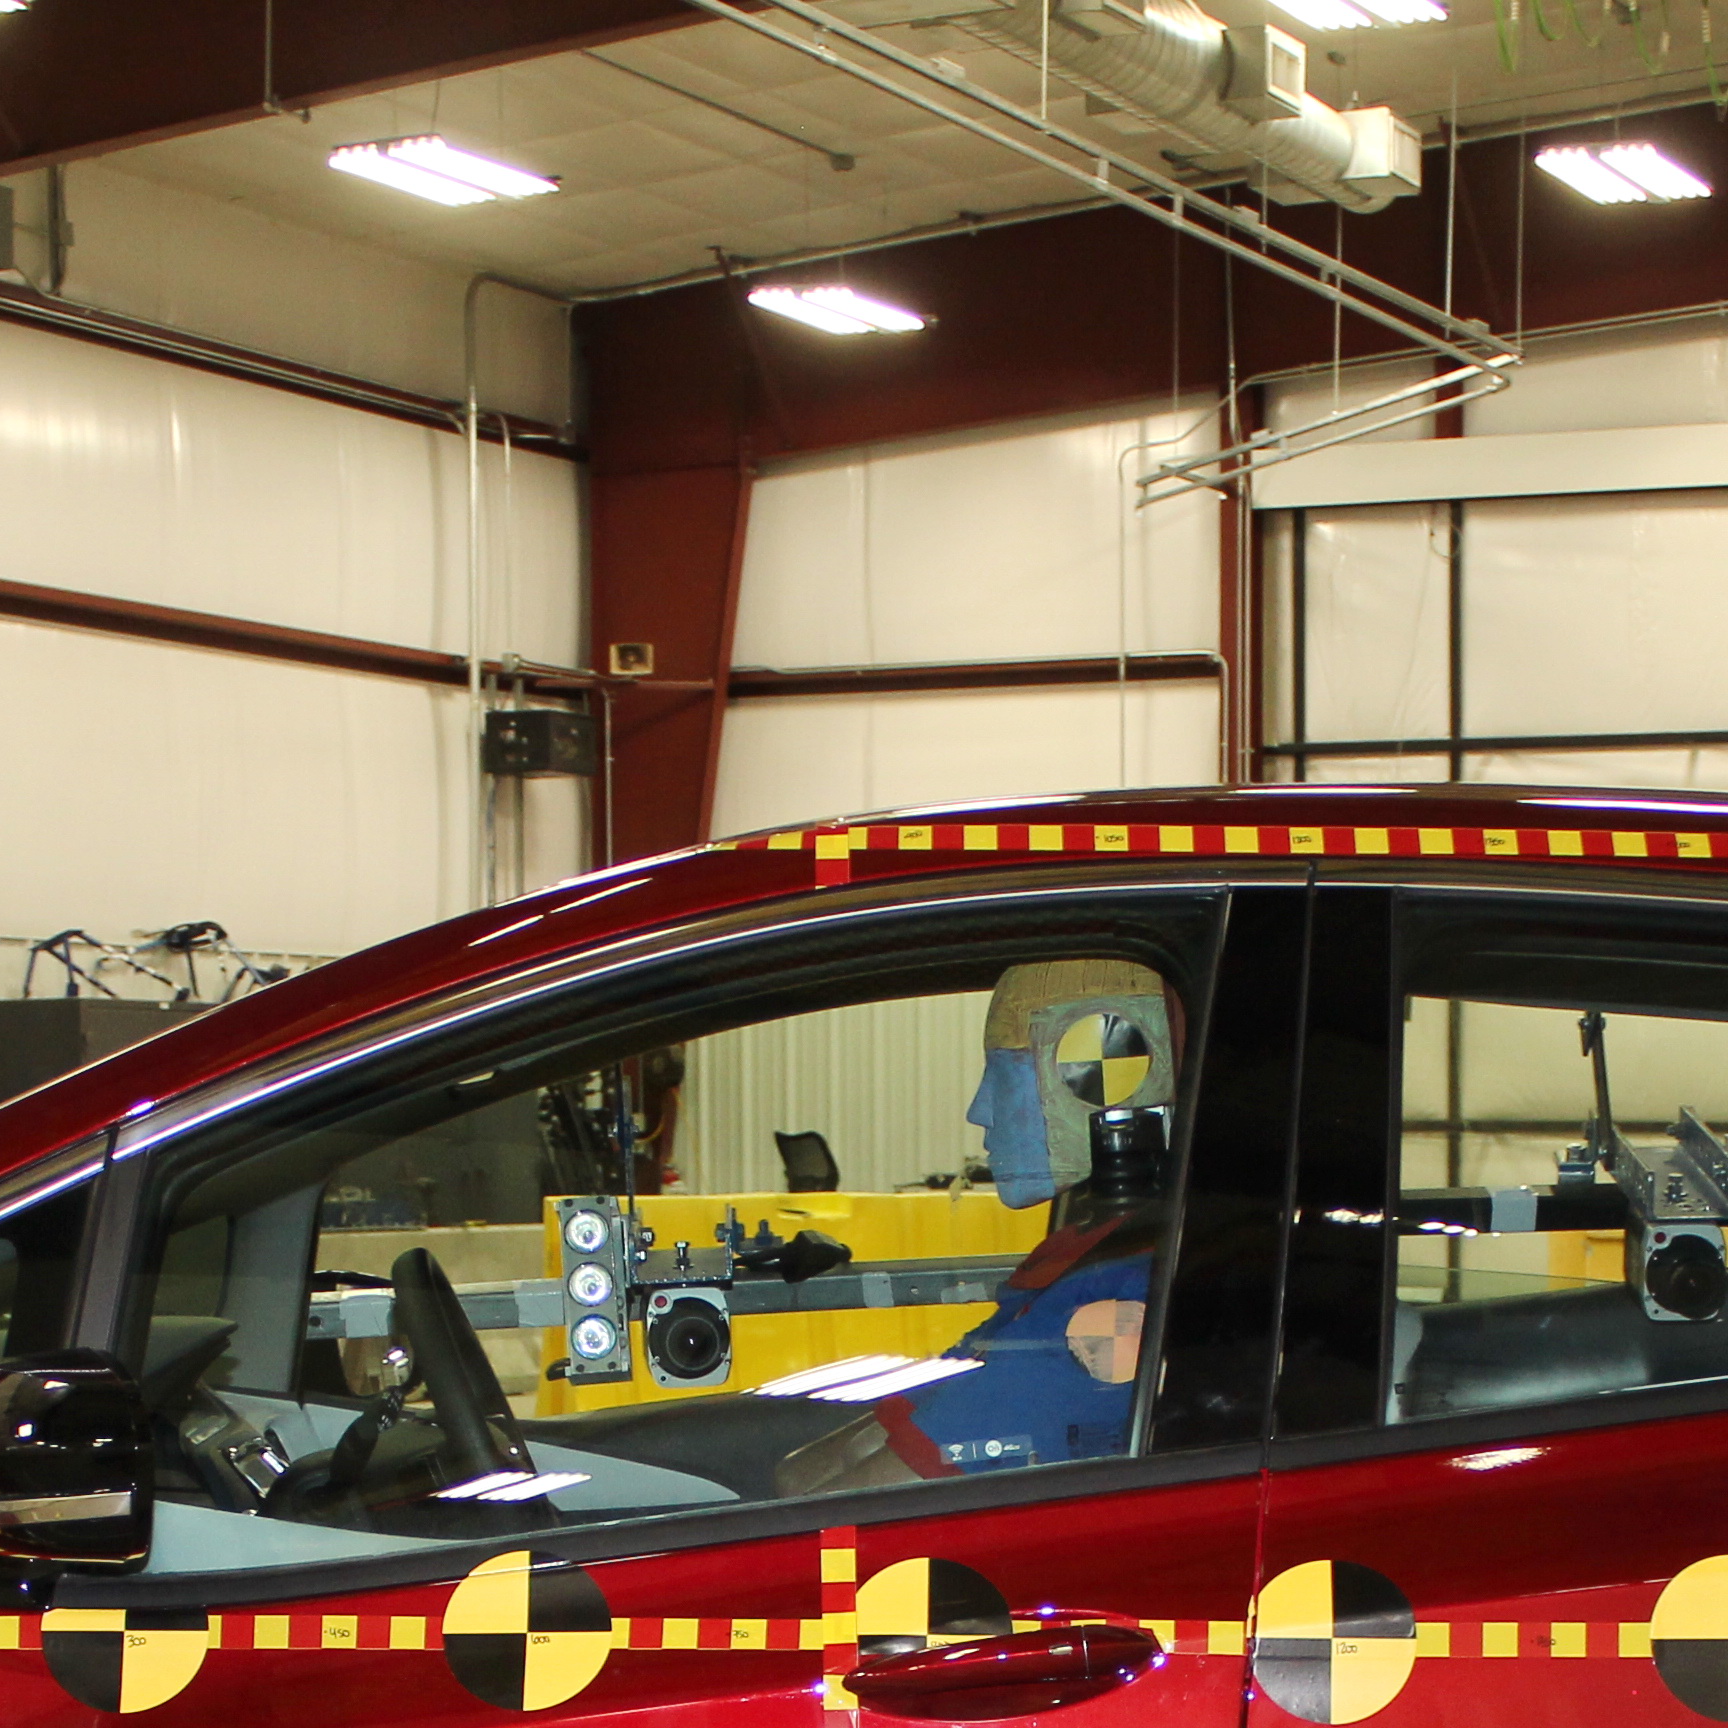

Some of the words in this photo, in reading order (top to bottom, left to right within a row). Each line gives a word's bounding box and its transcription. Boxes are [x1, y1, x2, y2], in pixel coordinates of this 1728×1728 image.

[329, 1627, 351, 1640] 450
[530, 1633, 551, 1645] 600
[126, 1633, 147, 1649] 300
[1335, 1641, 1359, 1655] 1200
